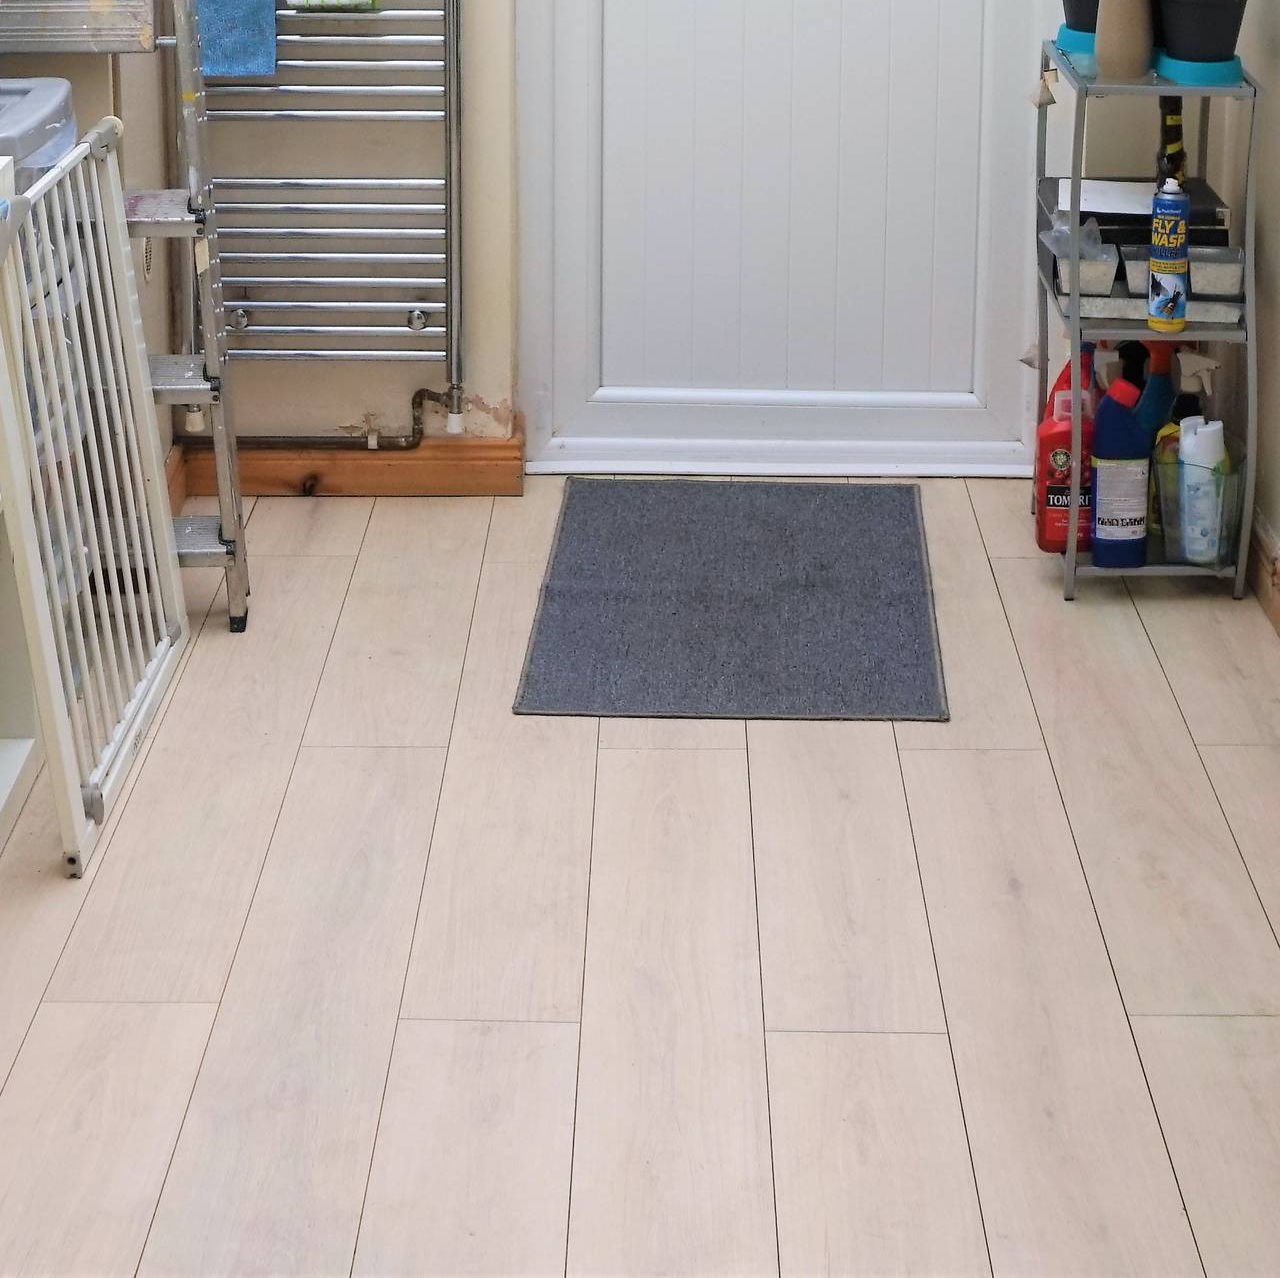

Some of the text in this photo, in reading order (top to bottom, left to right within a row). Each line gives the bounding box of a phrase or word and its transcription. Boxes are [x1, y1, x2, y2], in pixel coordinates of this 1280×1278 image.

[1152, 217, 1176, 235] FLY
[1176, 219, 1187, 235] &
[1151, 233, 1187, 249] WASP
